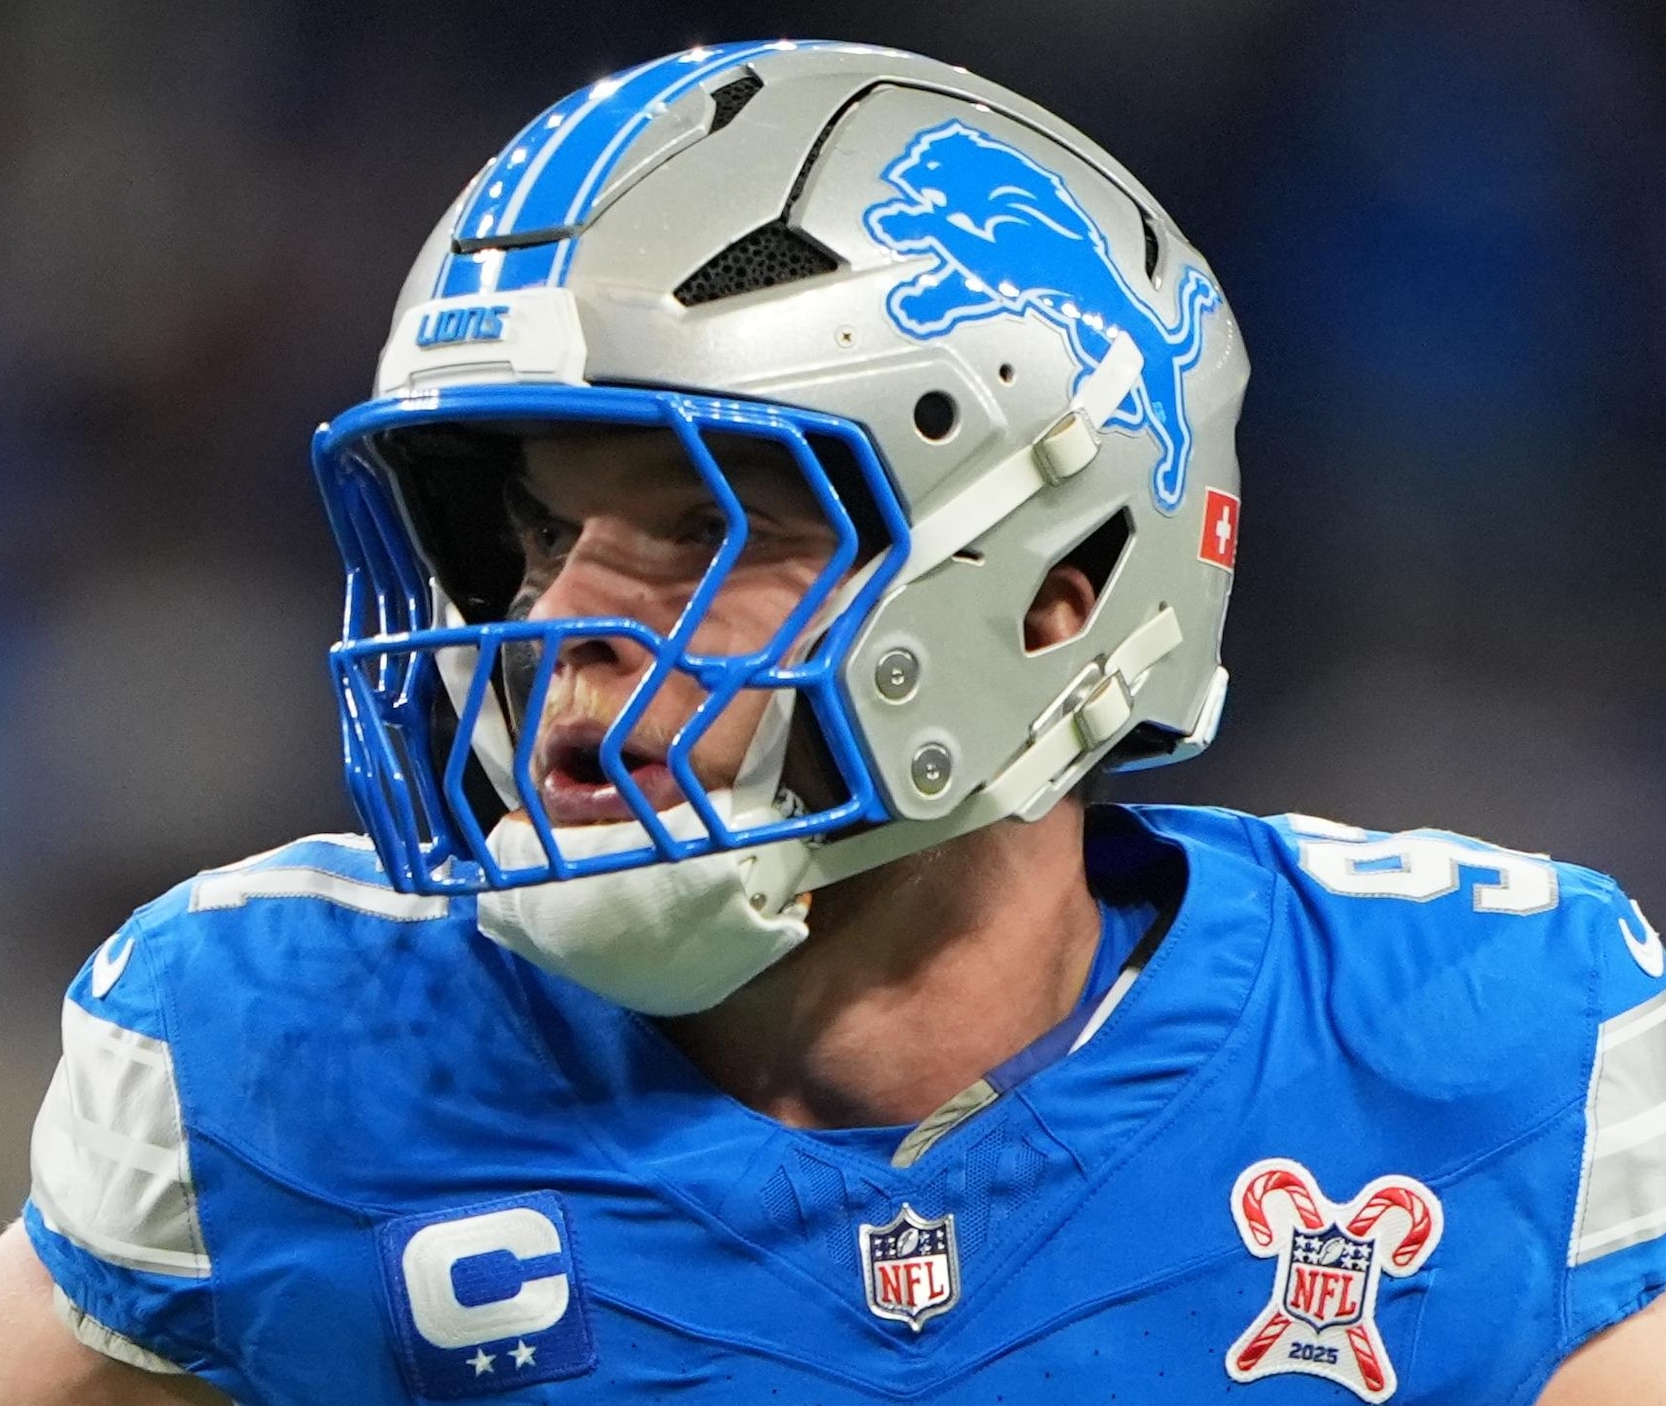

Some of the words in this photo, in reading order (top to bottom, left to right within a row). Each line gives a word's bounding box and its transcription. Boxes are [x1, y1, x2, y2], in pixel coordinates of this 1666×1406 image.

[416, 305, 510, 347] LIONS
[402, 1207, 570, 1350] C
[879, 1261, 944, 1308] NFL
[1290, 1267, 1357, 1321] NFL
[1288, 1341, 1340, 1365] 2025
